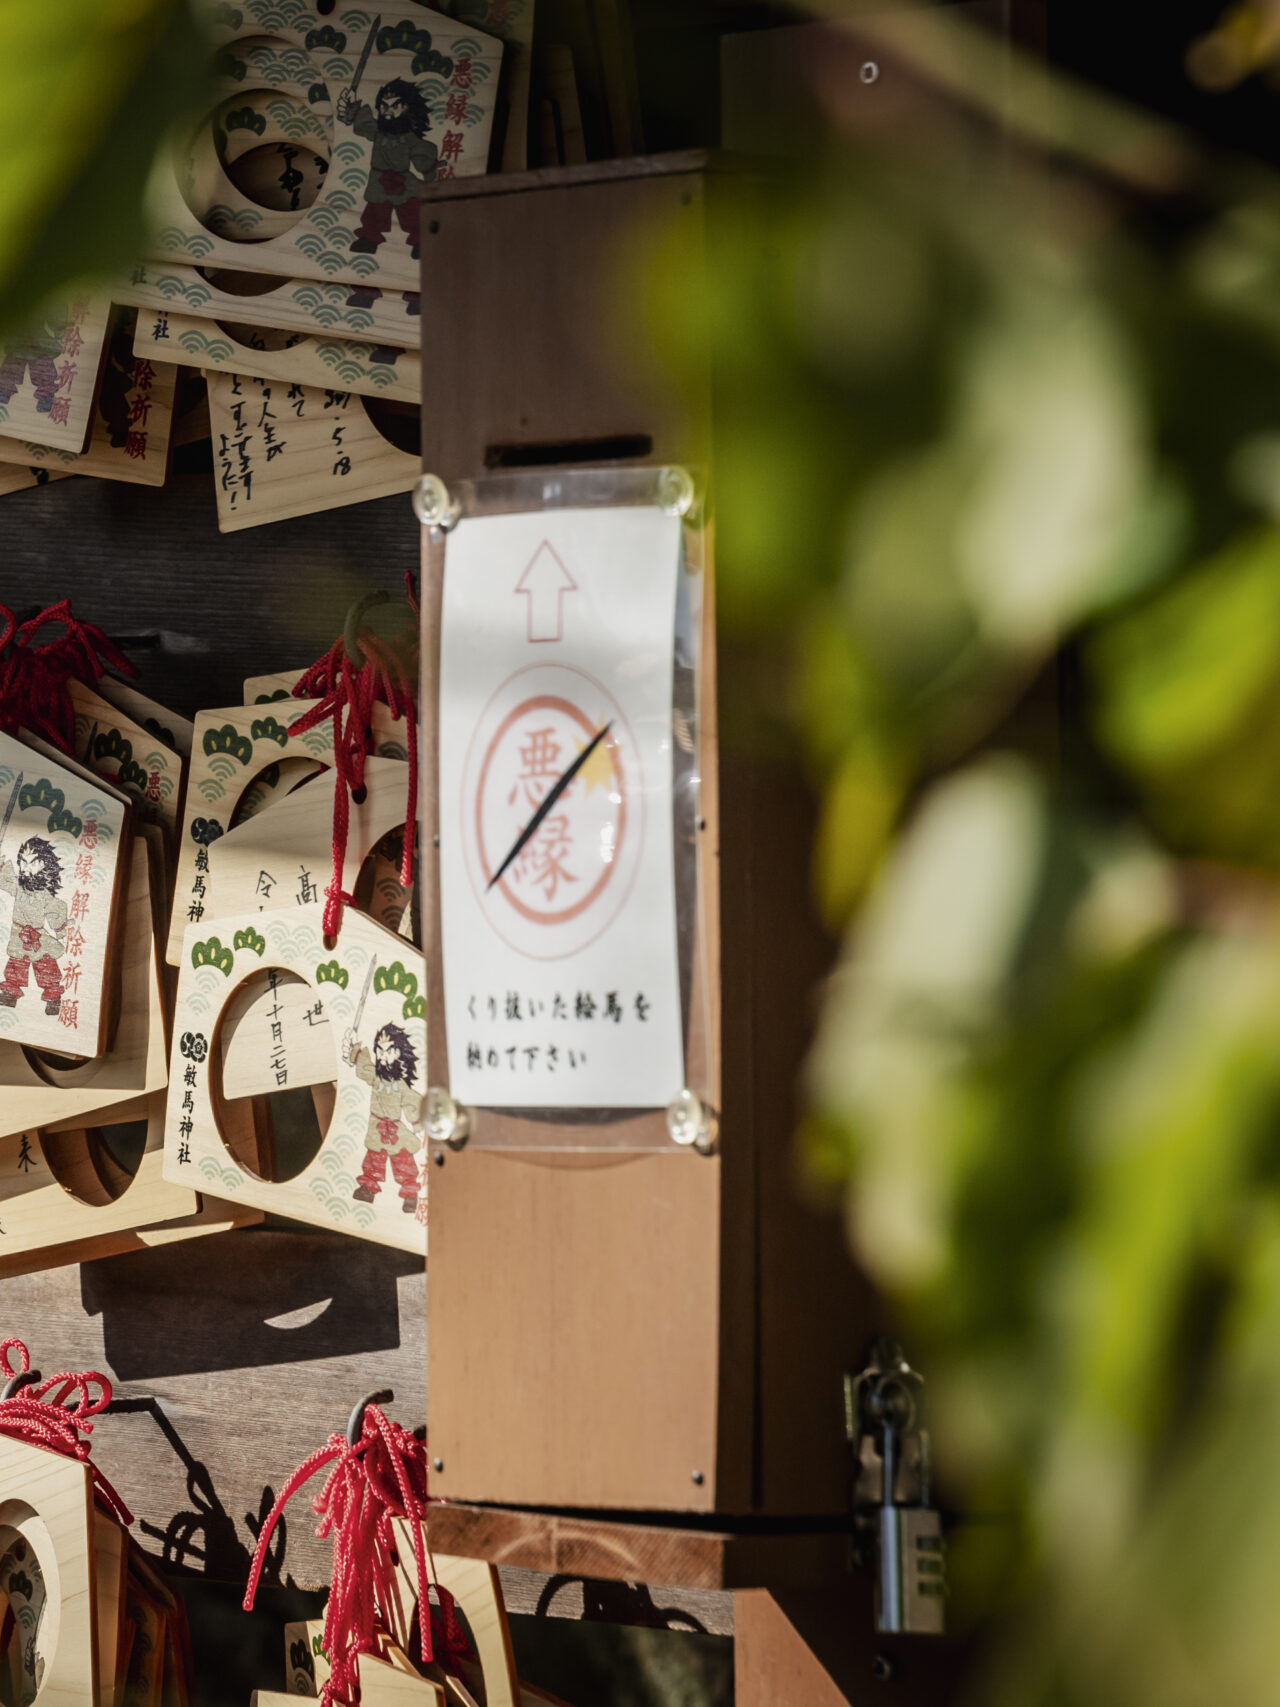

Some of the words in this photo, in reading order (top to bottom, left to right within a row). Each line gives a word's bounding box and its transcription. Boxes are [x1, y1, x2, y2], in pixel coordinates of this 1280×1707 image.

[57, 817, 101, 1031] 悪縁解除祈願
[465, 1041, 589, 1074] 納めて下さい
[178, 1062, 199, 1167] 敏馬神社
